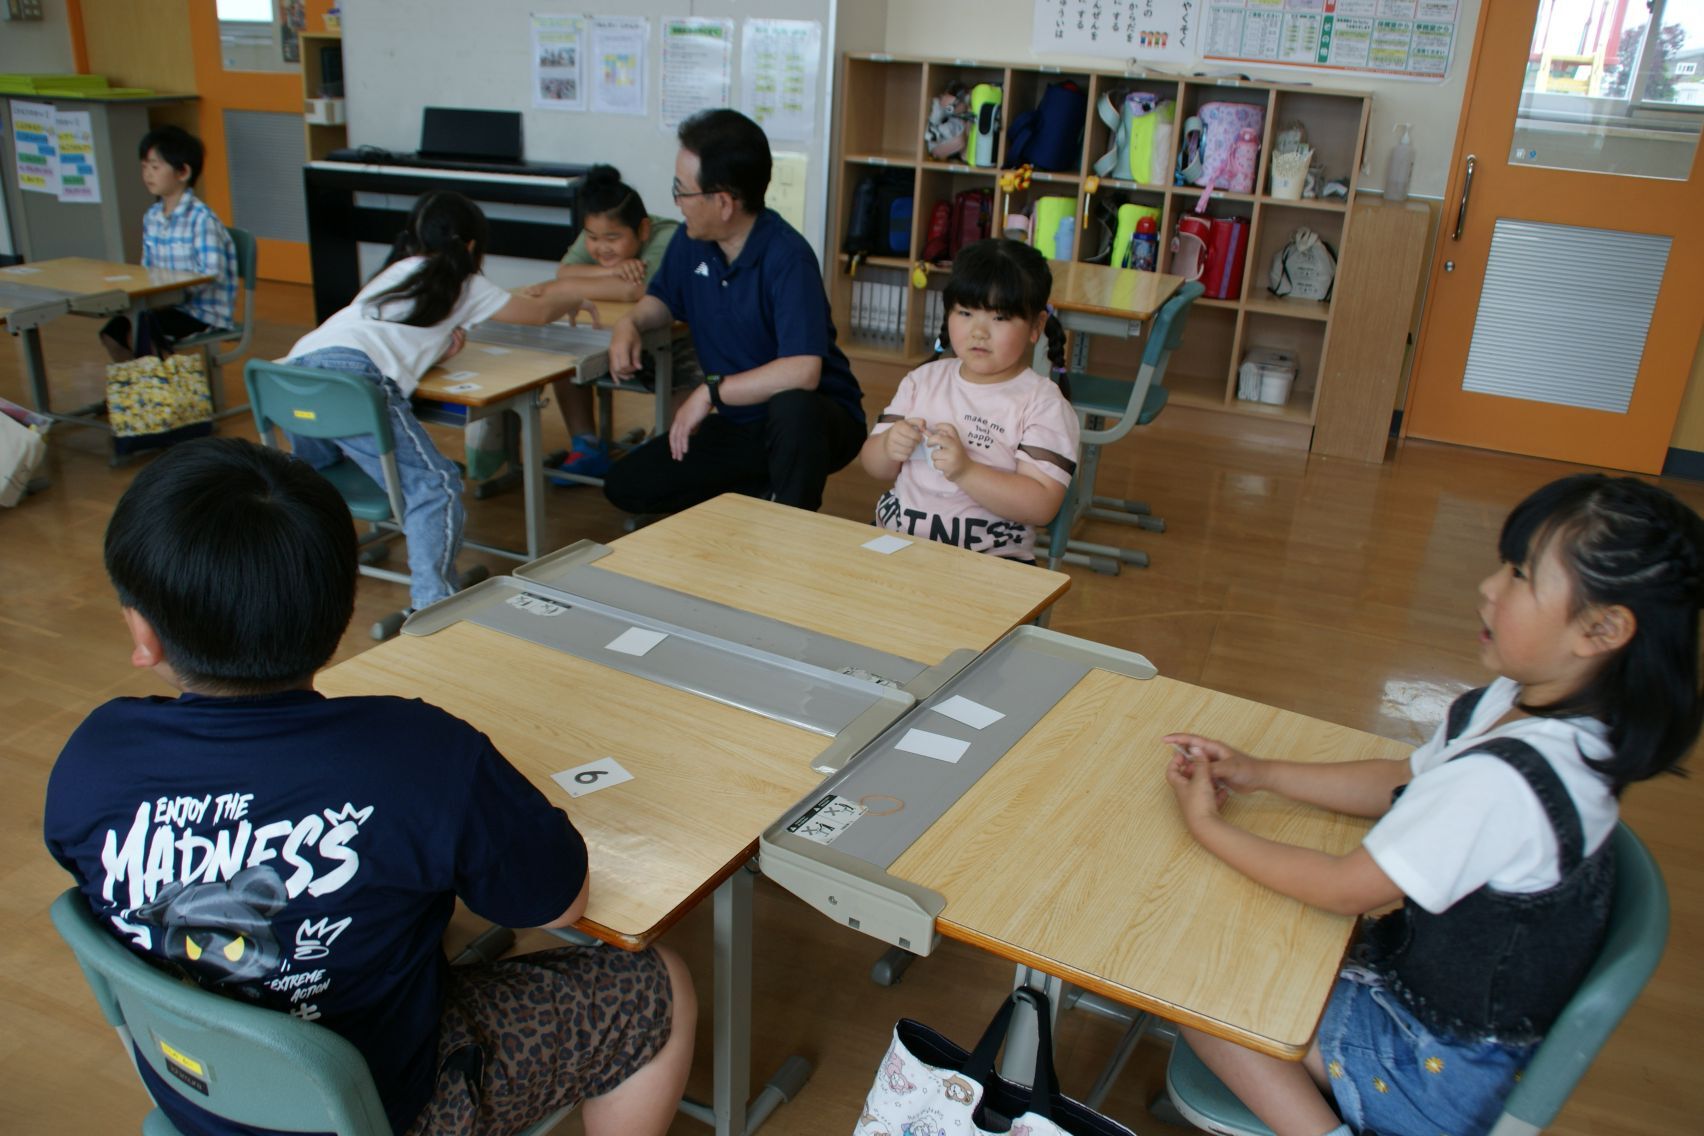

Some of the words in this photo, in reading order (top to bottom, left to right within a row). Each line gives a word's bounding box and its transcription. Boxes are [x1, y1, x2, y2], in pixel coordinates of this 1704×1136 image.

[1180, 1, 1192, 47] やくそく
[964, 414, 988, 425] make
[990, 423, 1005, 434] me
[154, 794, 212, 828] ENJOY
[213, 792, 254, 826] THE
[101, 801, 360, 910] MADNESS
[270, 968, 327, 991] EXTREME
[290, 978, 331, 1003] ACTION
